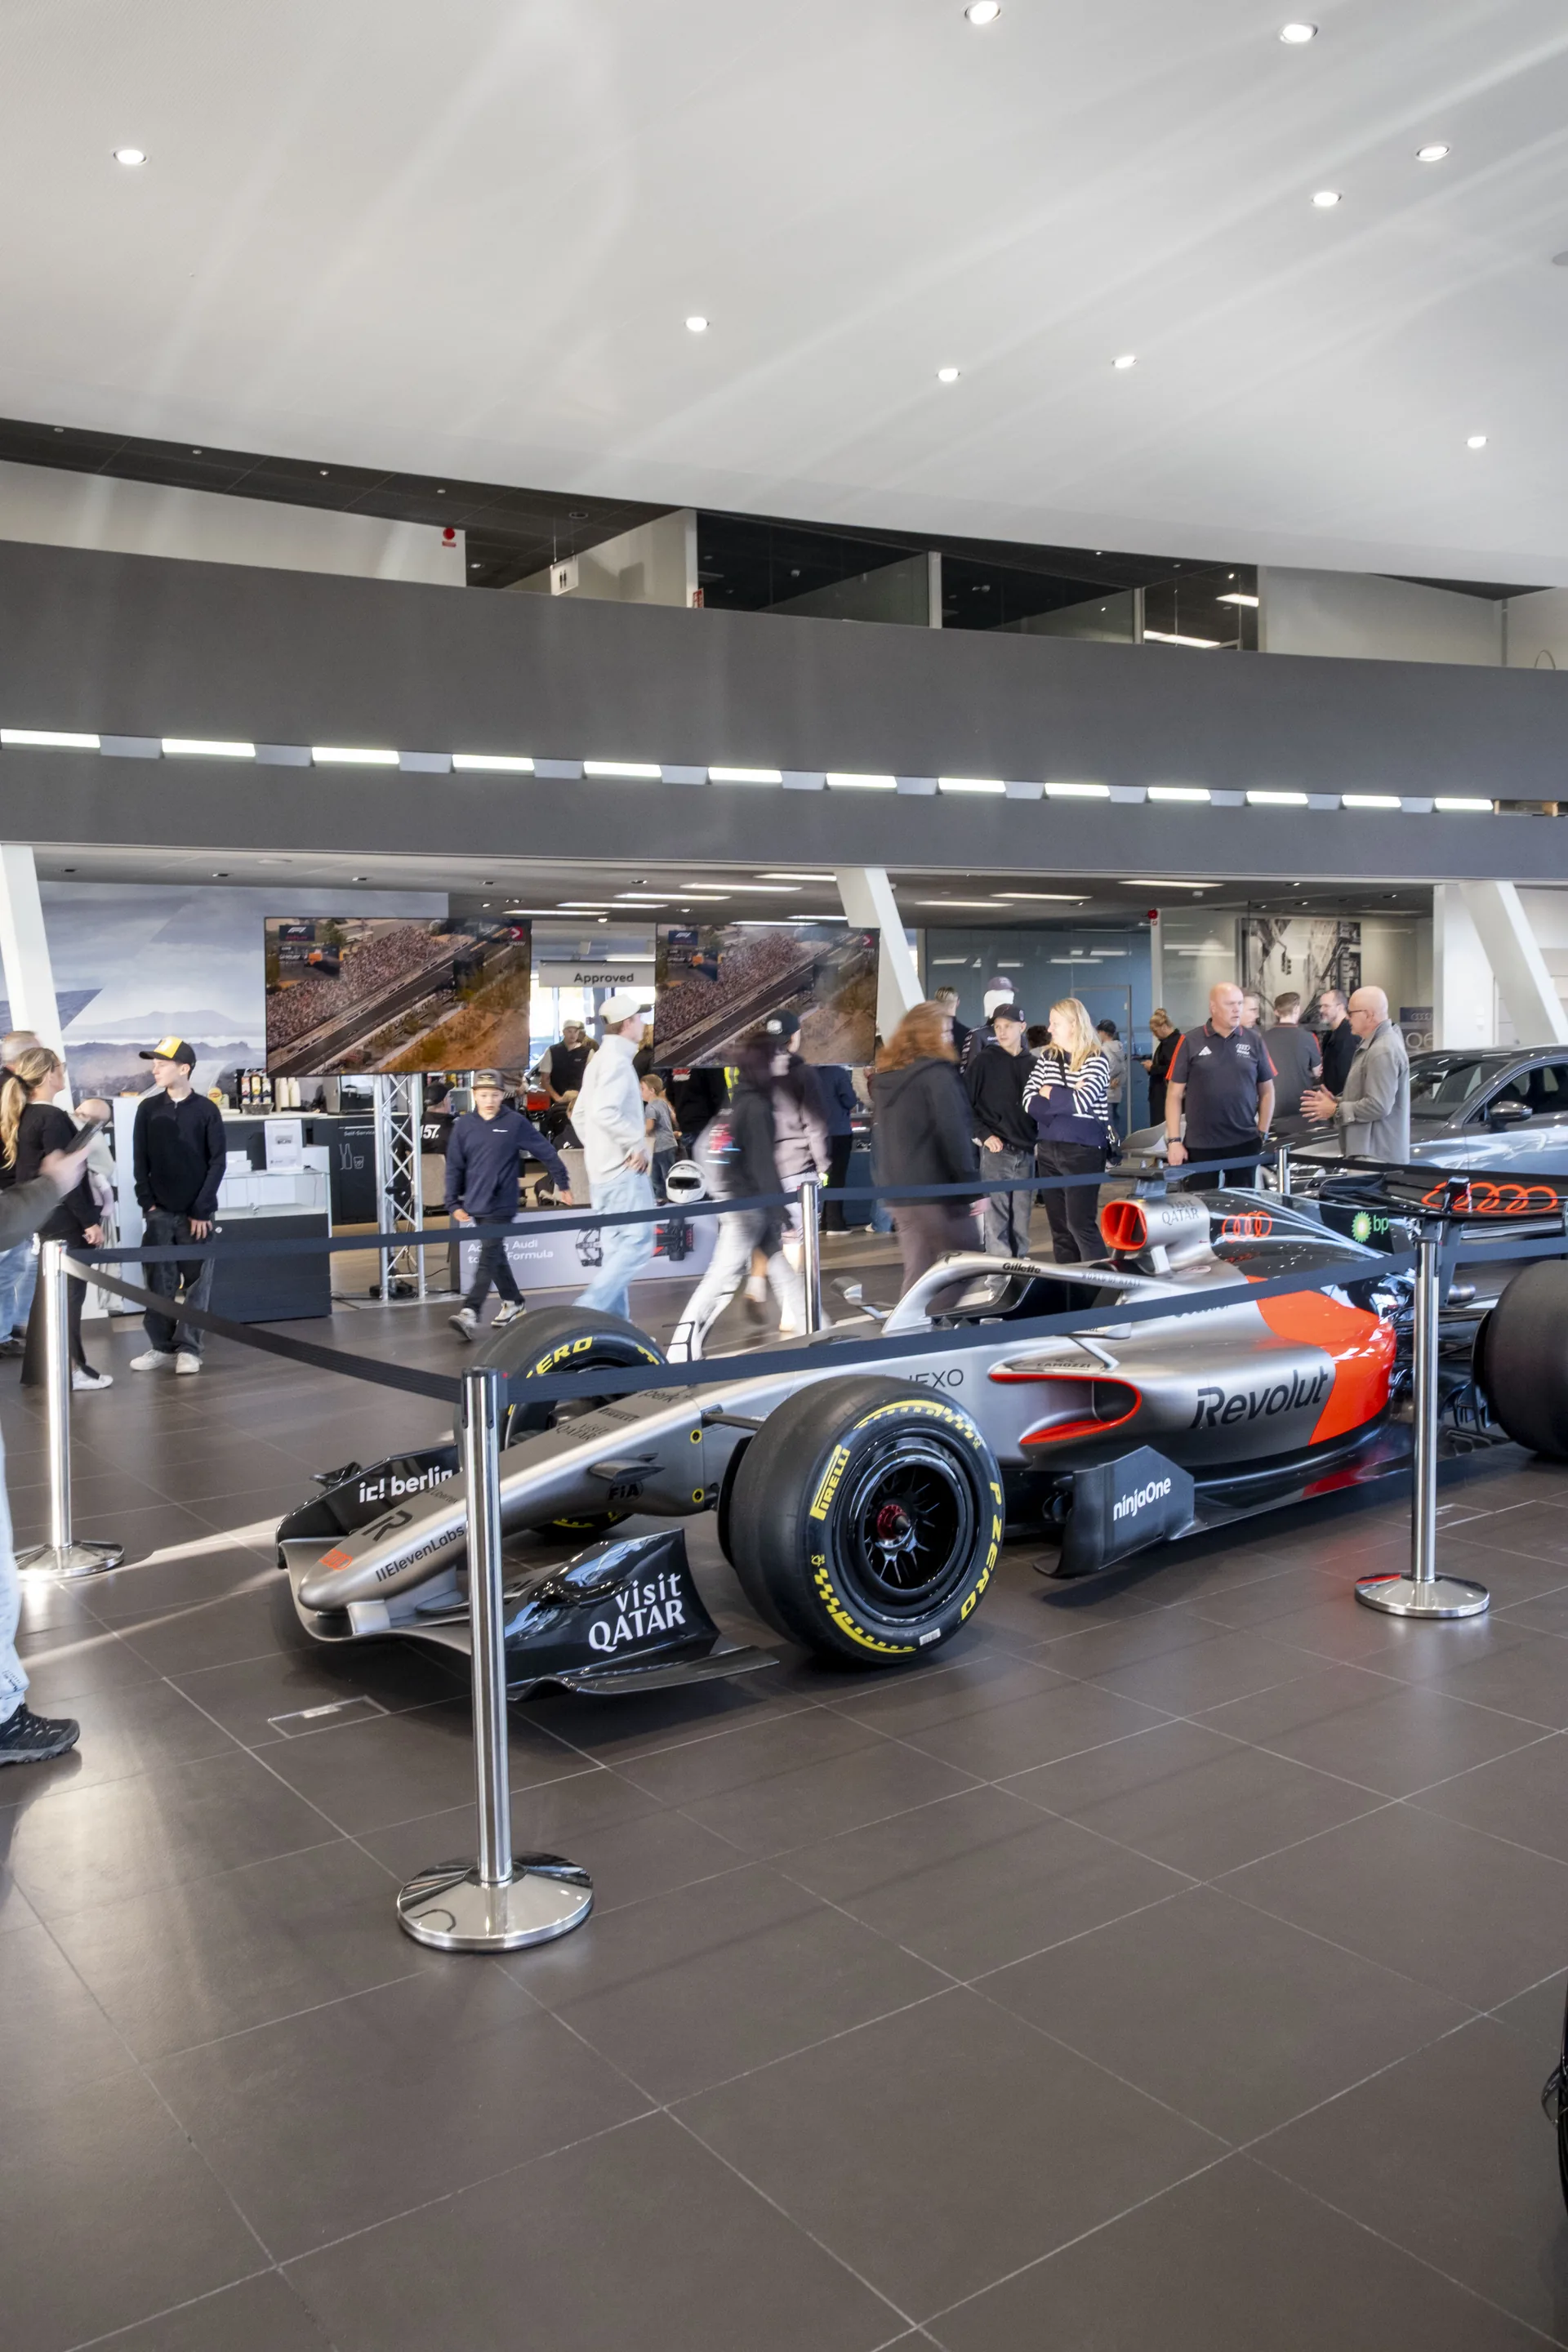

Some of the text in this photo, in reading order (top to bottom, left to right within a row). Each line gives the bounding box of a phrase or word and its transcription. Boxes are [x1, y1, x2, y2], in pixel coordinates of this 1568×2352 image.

[573, 973, 635, 985] Approved
[1161, 1207, 1200, 1226] QATAR
[1373, 1214, 1389, 1235] bp
[507, 1250, 555, 1262] Formula
[511, 1239, 539, 1250] Audi
[1002, 1262, 1042, 1275] Gillette
[526, 1336, 594, 1379] ERO
[909, 1368, 964, 1389] EXO
[1189, 1365, 1329, 1429] Revolut
[390, 1465, 453, 1497] berlin
[809, 1444, 851, 1521] PIRELLI
[1113, 1477, 1171, 1521] ninjaOne
[960, 1481, 1003, 1621] P ZERO
[614, 1572, 681, 1613] visit
[588, 1599, 687, 1653] QATAR
